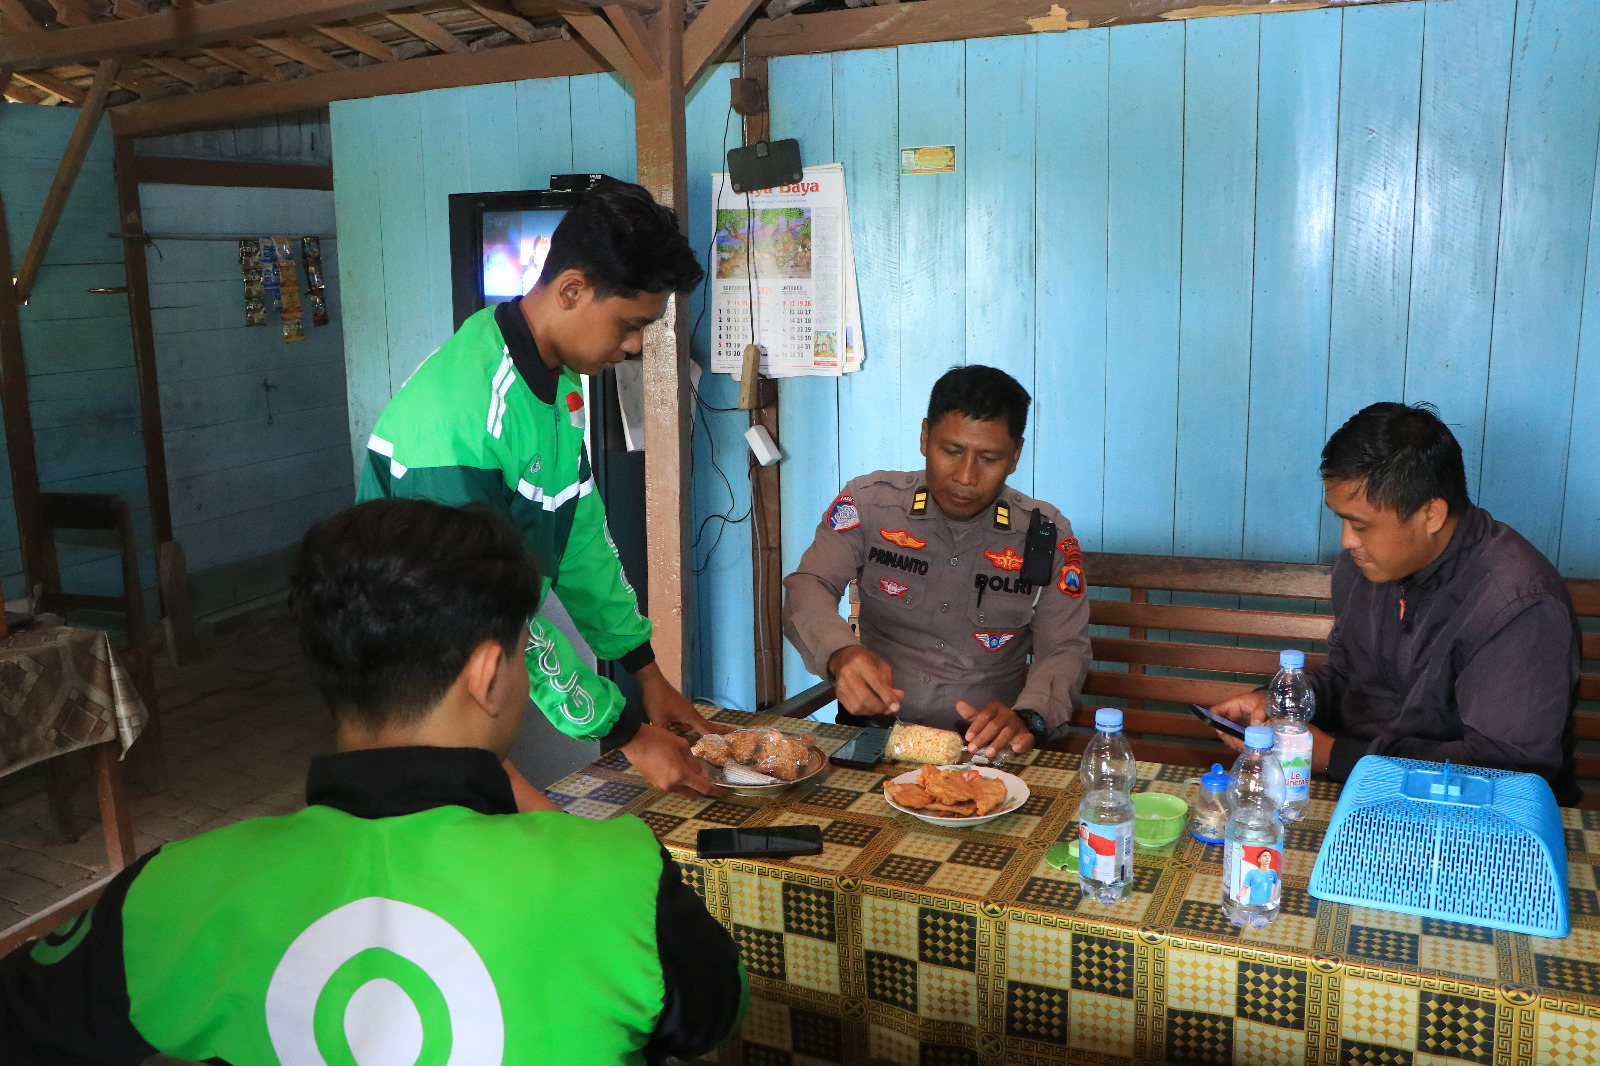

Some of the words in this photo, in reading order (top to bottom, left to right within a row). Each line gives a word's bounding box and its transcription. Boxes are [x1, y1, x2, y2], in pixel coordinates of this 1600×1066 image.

[779, 182, 820, 196] Baya
[974, 573, 1033, 595] POLRI
[1285, 777, 1309, 786] inerale
[1291, 772, 1301, 780] Le
